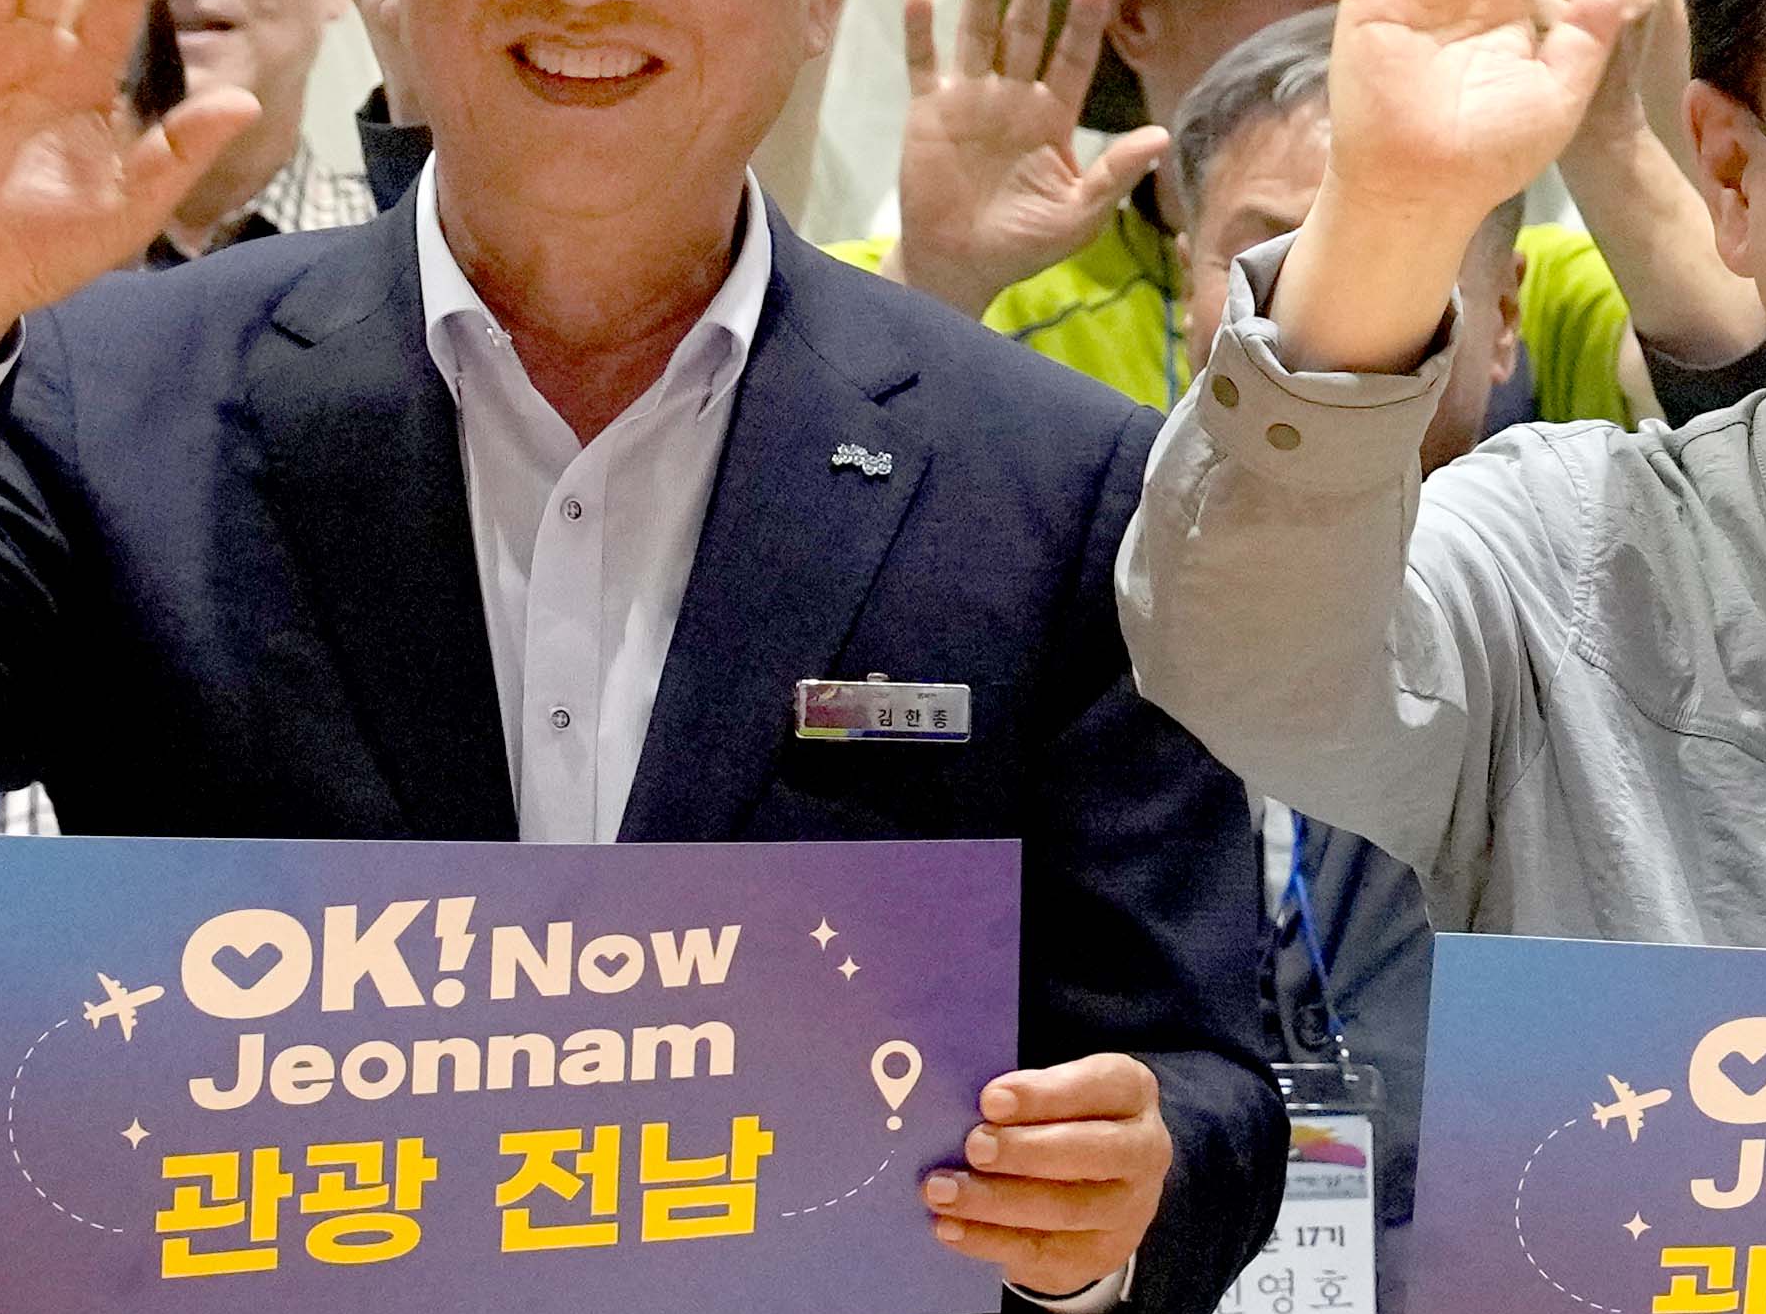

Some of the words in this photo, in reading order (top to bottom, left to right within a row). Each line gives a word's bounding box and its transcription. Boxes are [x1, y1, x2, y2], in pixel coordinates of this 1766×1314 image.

[179, 895, 480, 1021] OK!
[488, 922, 744, 1000] Now
[187, 1020, 737, 1112] Jeonnam
[154, 1133, 438, 1281] 관광
[494, 1114, 775, 1256] 전남
[1296, 1225, 1345, 1247] 17기
